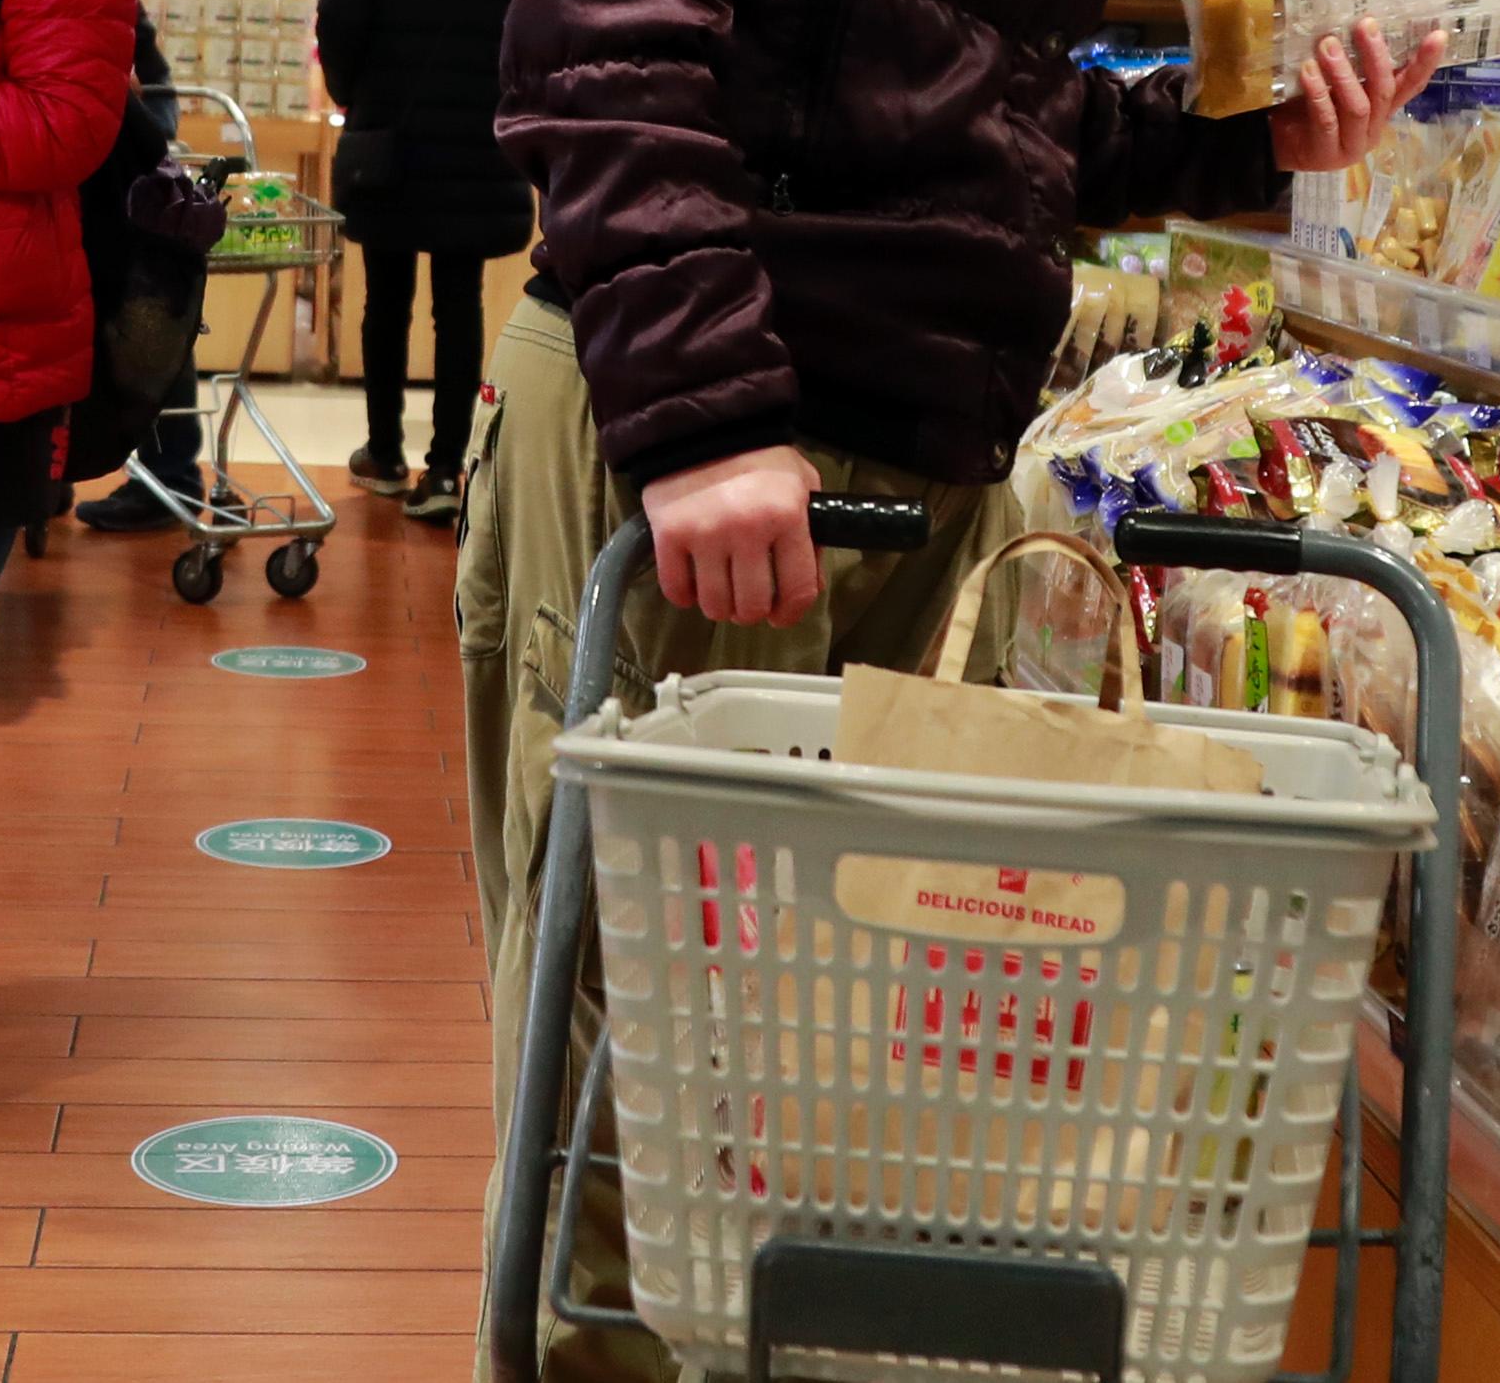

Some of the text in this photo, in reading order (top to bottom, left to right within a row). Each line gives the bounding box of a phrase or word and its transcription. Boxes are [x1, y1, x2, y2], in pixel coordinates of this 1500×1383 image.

[916, 889, 1097, 934] DELICIOUS BREAD
[176, 1142, 352, 1153] Waiting Area
[174, 1153, 357, 1176] 等候区
